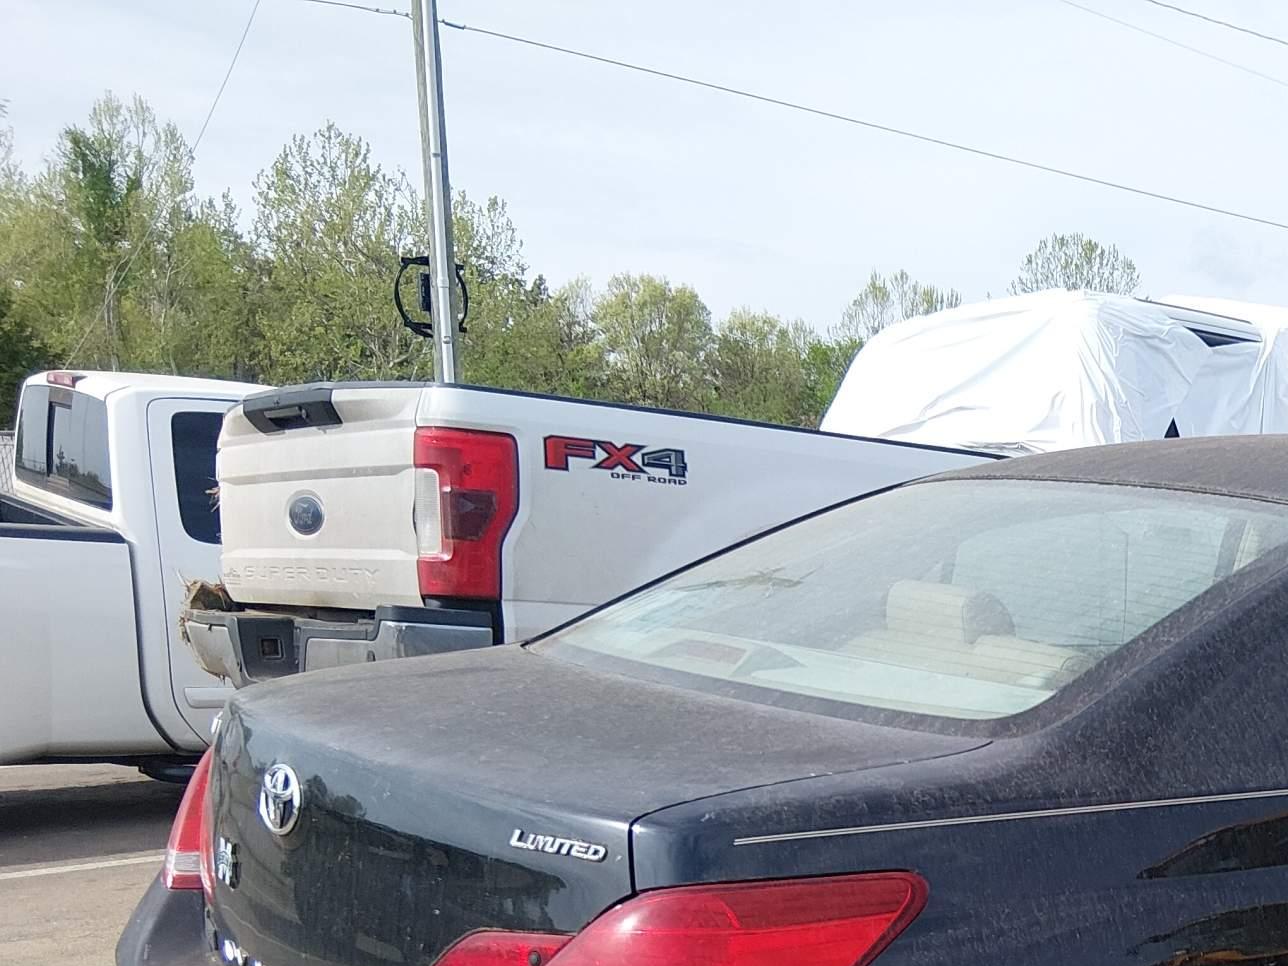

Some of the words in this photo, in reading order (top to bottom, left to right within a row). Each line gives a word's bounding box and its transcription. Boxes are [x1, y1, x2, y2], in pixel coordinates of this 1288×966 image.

[543, 435, 688, 478] FX4
[610, 471, 641, 481] OFF
[647, 475, 688, 486] ROAD
[243, 564, 312, 584] SUPER
[315, 567, 380, 585] DUTY
[509, 828, 609, 863] LIMITED
